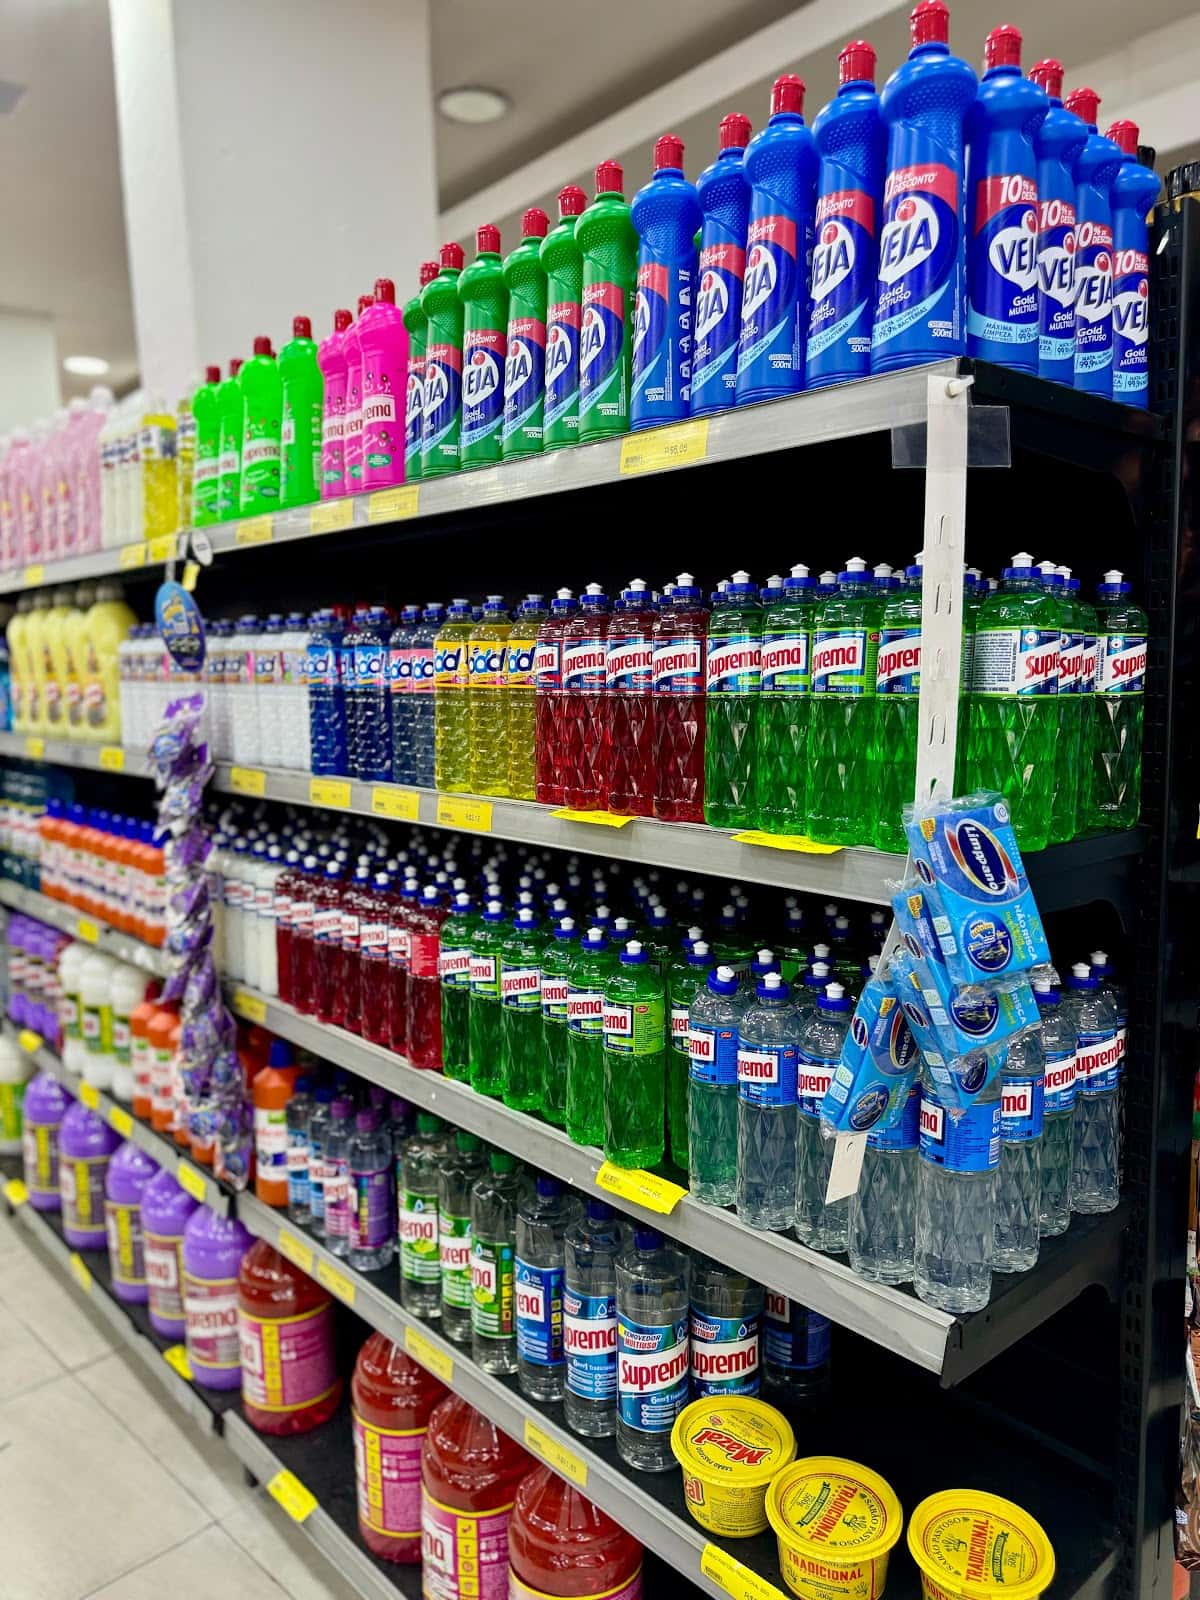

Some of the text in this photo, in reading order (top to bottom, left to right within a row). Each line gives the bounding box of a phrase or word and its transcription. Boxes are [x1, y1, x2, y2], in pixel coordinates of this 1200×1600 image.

[1013, 293, 1034, 306] Gold
[1054, 311, 1073, 322] Gold
[932, 327, 953, 338] 500ml
[1077, 325, 1103, 337] Gold
[1125, 349, 1146, 358] Gold
[771, 359, 792, 369] 500ml
[964, 825, 999, 891] Limpano
[694, 1430, 769, 1464] Mazal
[810, 1485, 858, 1542] TRADICIONAL
[966, 1519, 989, 1583] TRADICIONAL
[787, 1550, 863, 1581] TRADICIONAL
